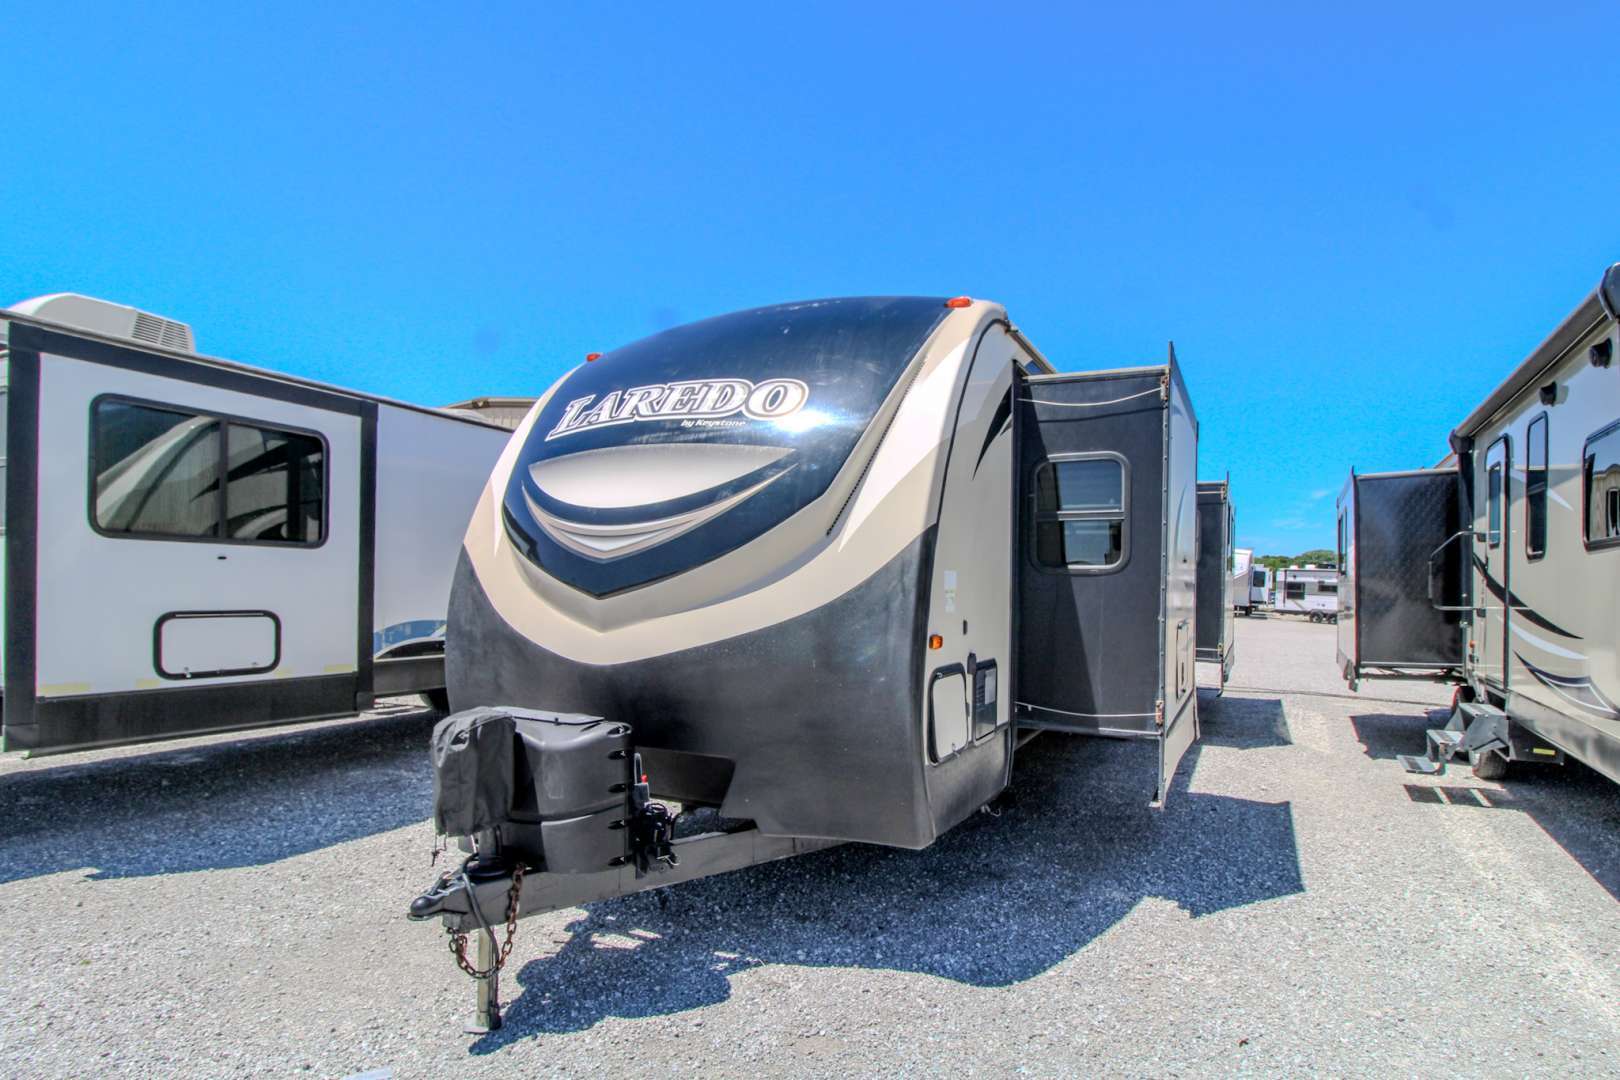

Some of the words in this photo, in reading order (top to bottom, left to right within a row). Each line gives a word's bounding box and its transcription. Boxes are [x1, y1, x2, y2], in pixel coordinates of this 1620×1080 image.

[545, 378, 809, 441] LAREDO
[680, 419, 695, 428] by
[695, 419, 747, 428] Keystone
